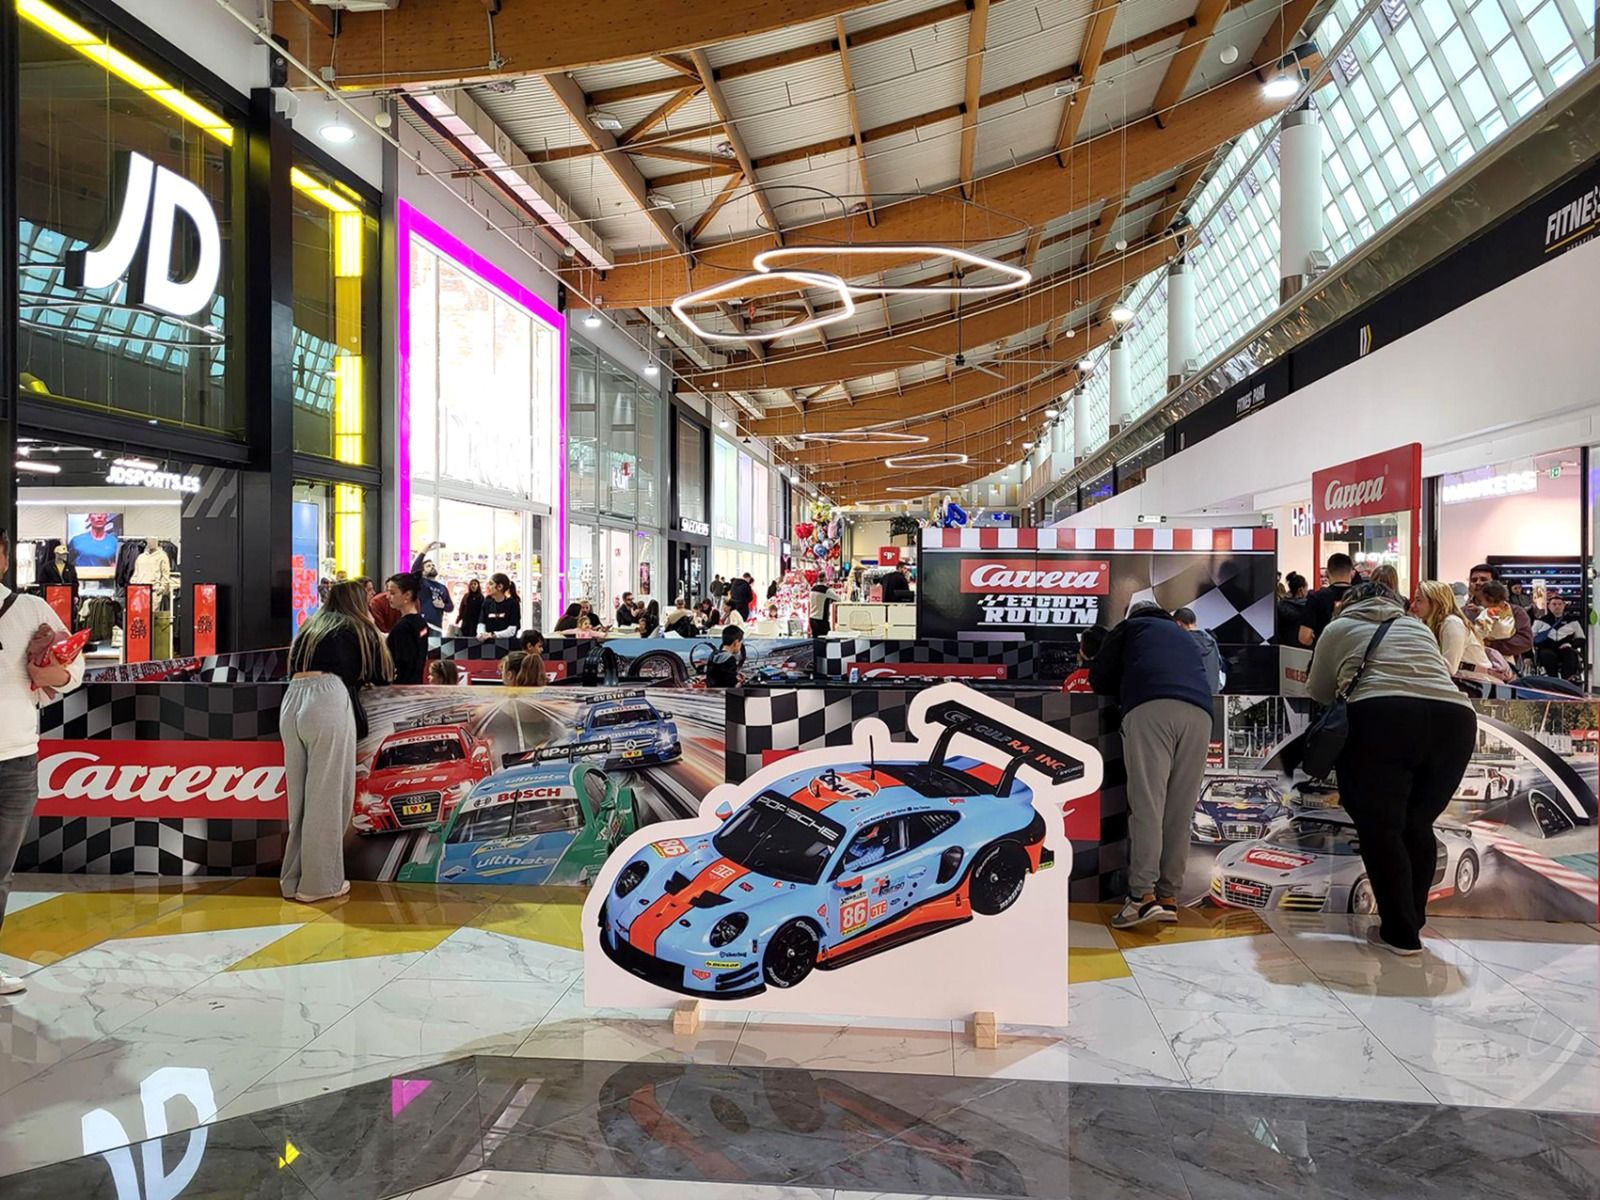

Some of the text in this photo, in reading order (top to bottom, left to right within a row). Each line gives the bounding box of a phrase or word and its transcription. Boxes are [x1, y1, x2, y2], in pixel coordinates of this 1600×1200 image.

[84, 150, 221, 316] JD
[1324, 476, 1385, 512] Carrera
[969, 564, 1099, 589] Carrera
[1007, 595, 1099, 608] ESCAPE
[37, 751, 287, 802] Carrera
[497, 787, 561, 803] BOSCH
[756, 795, 839, 841] PORSCHE
[476, 852, 557, 869] ultimate
[658, 840, 685, 856] 86
[843, 902, 866, 928] 86
